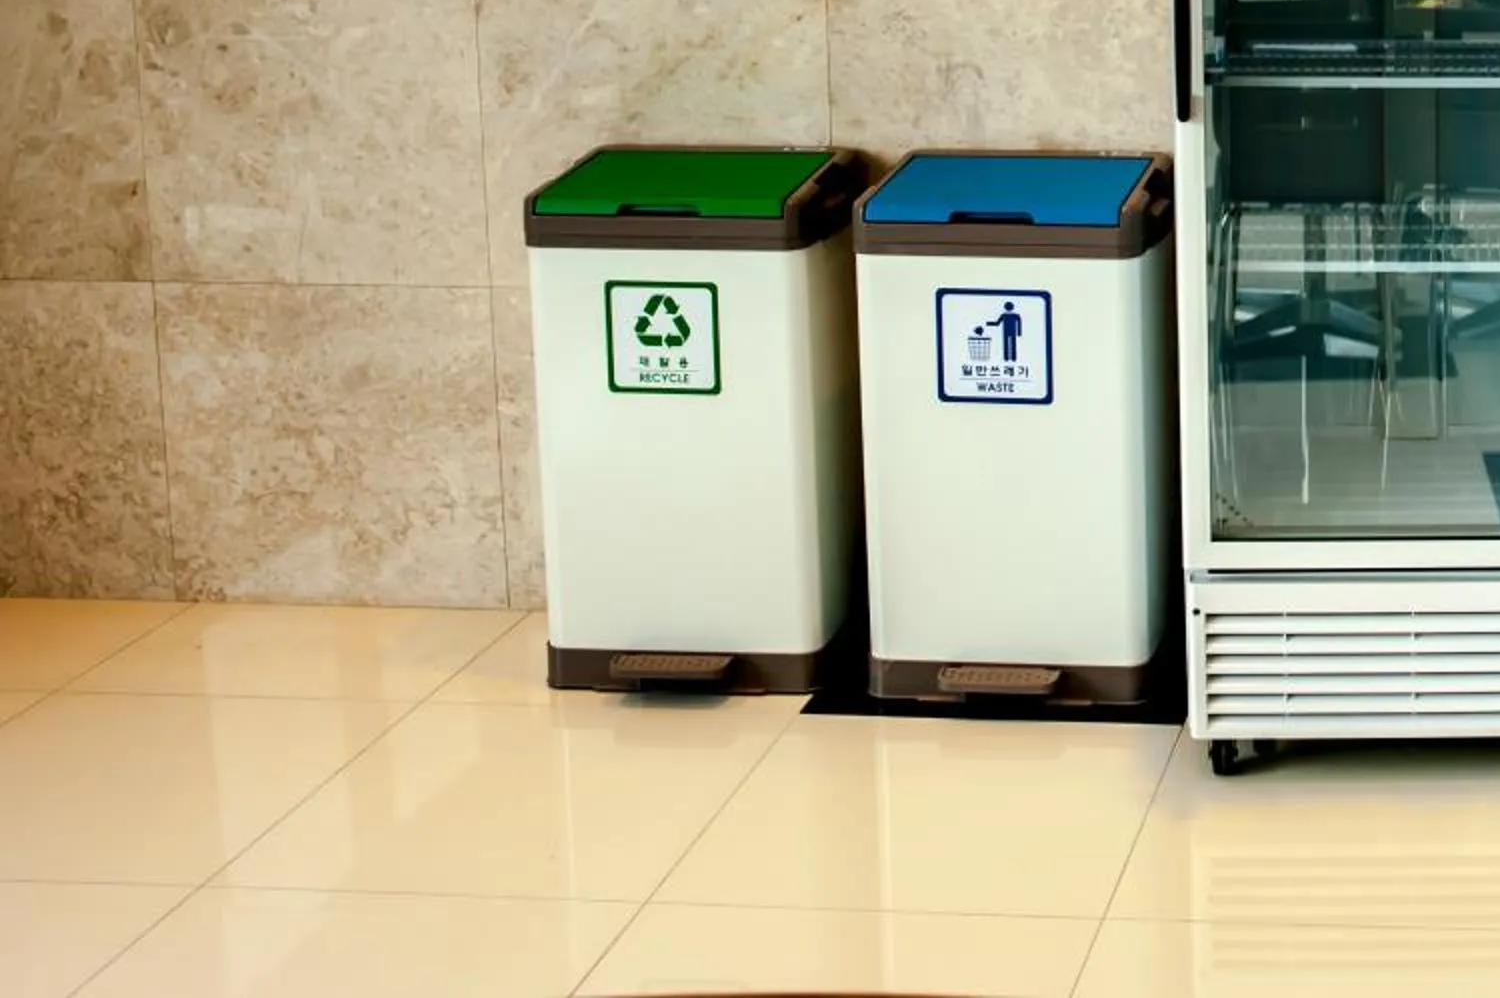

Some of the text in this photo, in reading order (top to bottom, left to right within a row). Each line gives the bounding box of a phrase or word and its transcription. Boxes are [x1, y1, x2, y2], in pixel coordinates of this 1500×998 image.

[961, 364, 1029, 379] 일반쓰레기
[639, 373, 690, 384] RECYCLE
[976, 381, 1016, 394] WASTE
